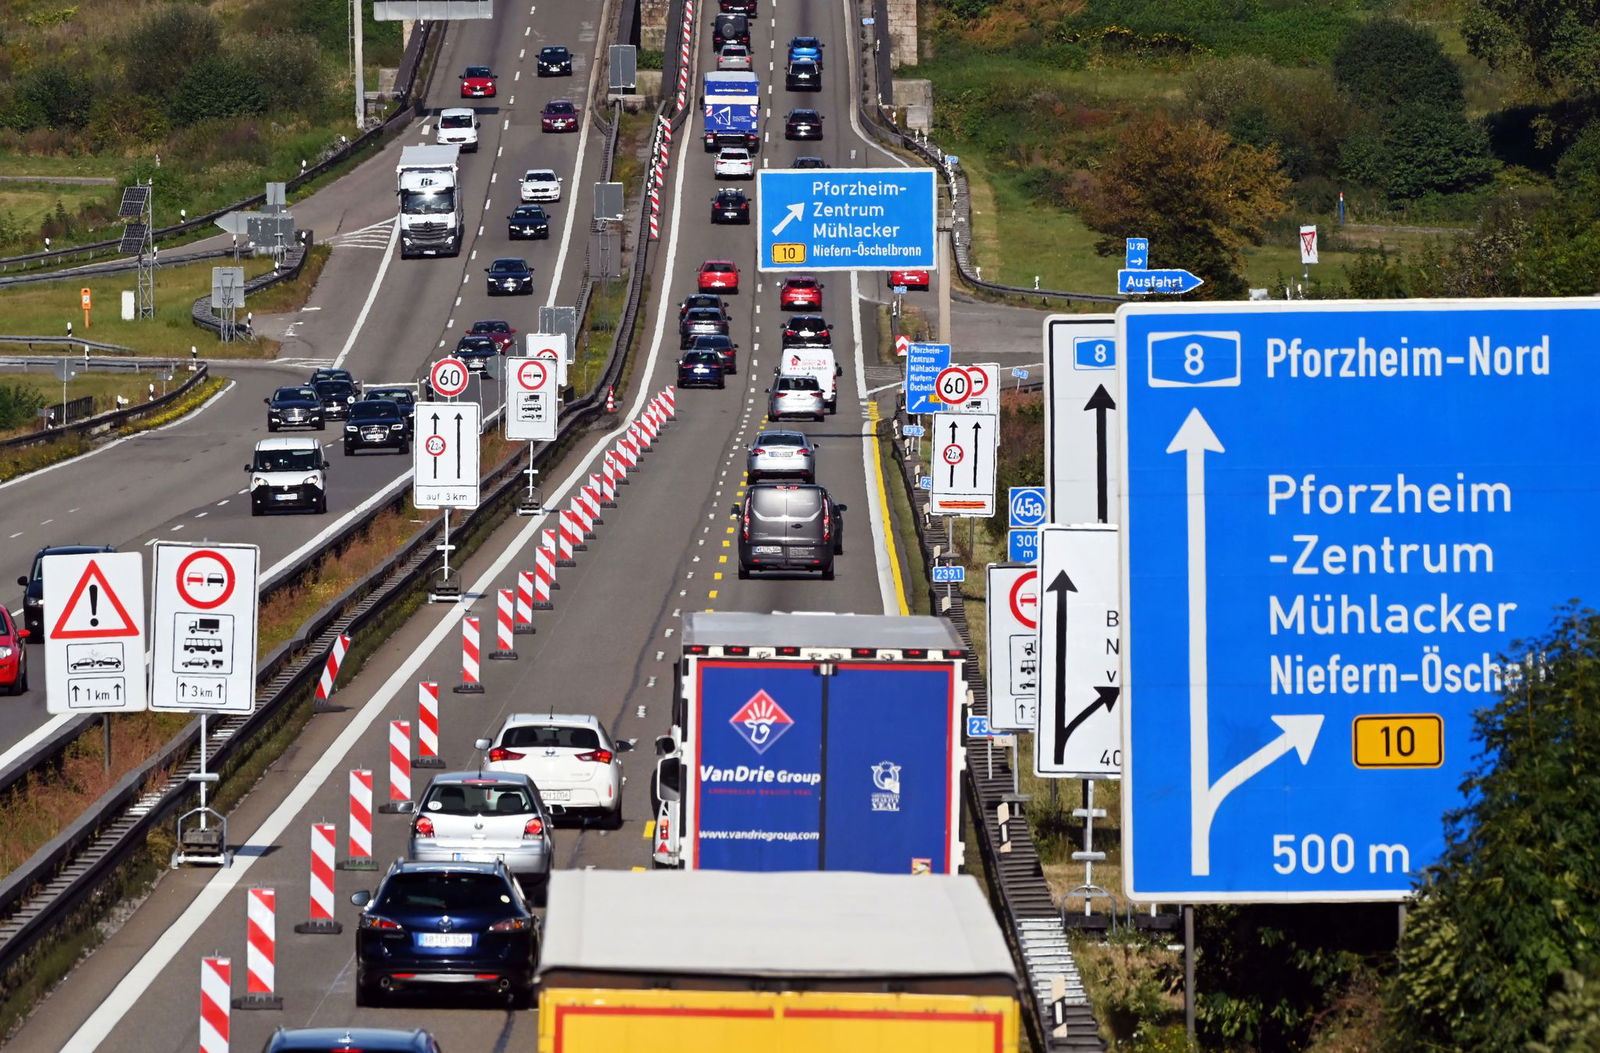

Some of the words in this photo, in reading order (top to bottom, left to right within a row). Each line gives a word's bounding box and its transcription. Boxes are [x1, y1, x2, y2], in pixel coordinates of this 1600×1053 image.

[812, 181, 907, 196] Pforzheim-
[813, 202, 885, 217] Zentrum
[813, 222, 900, 238] Mühlacker
[782, 247, 796, 259] 10
[813, 241, 922, 257] Niefern-Öschelbronn
[1126, 275, 1184, 288] Ausfahrt
[910, 355, 936, 364] Zentrum
[1094, 344, 1107, 363] 8
[1184, 343, 1205, 376] 8
[1266, 334, 1550, 379] Pforzheim-Nord
[439, 369, 461, 387] 60
[943, 377, 965, 394] 60
[426, 492, 440, 502] auf
[446, 492, 451, 501] 3
[452, 492, 468, 501] km
[1268, 472, 1512, 516] Pforzheim
[1016, 498, 1042, 517] 45a
[1023, 550, 1034, 558] m
[1269, 534, 1494, 575] -Zentrum
[936, 569, 961, 580] 239.1
[1269, 592, 1518, 636] Mühlacker
[86, 688, 91, 700] 1
[95, 689, 110, 700] km
[191, 686, 198, 697] 3
[200, 688, 213, 698] km
[1380, 726, 1416, 757] 10
[700, 765, 775, 783] VanDrie
[777, 770, 821, 786] Group
[699, 829, 820, 842] www.vandriegroup.com
[1273, 833, 1355, 875] 500
[1369, 843, 1410, 873] m
